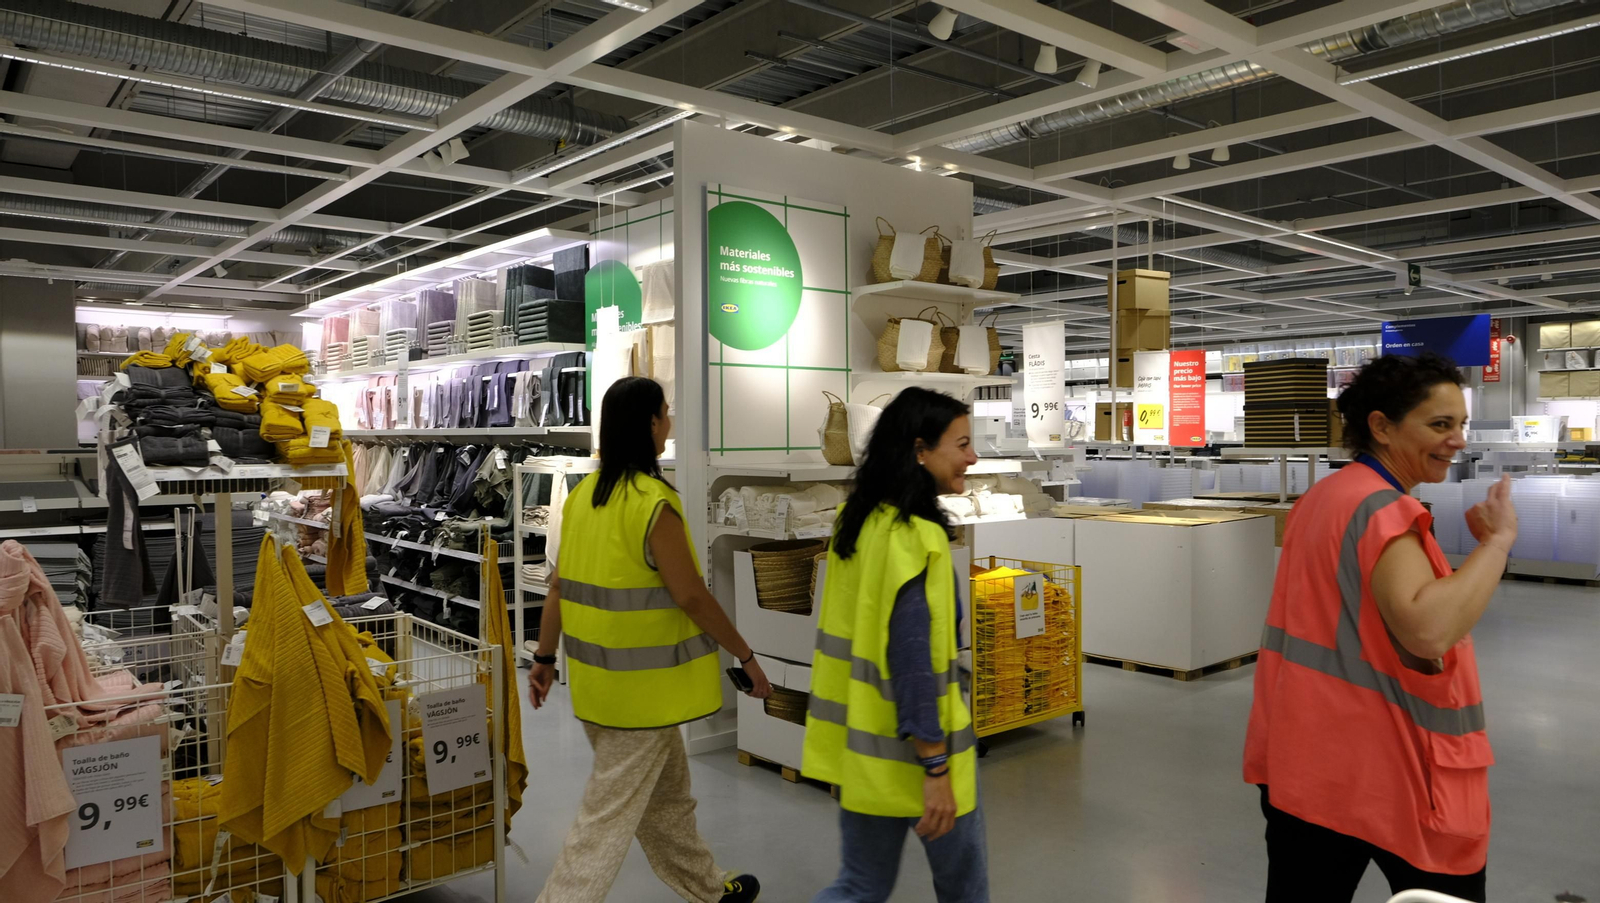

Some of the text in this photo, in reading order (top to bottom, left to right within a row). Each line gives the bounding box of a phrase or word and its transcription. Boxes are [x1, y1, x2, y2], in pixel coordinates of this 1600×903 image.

[720, 246, 771, 261] Materiales
[720, 261, 795, 278] más sostenibles
[720, 275, 739, 283] Nuevas
[739, 277, 754, 285] fibras
[722, 304, 738, 312] IKEA
[619, 321, 642, 332] enibles
[426, 707, 458, 719] VÅGSJÖN
[72, 751, 130, 766] Toalla de baño
[72, 762, 118, 776] VÅGSJÖN
[78, 794, 149, 831] 9,99€
